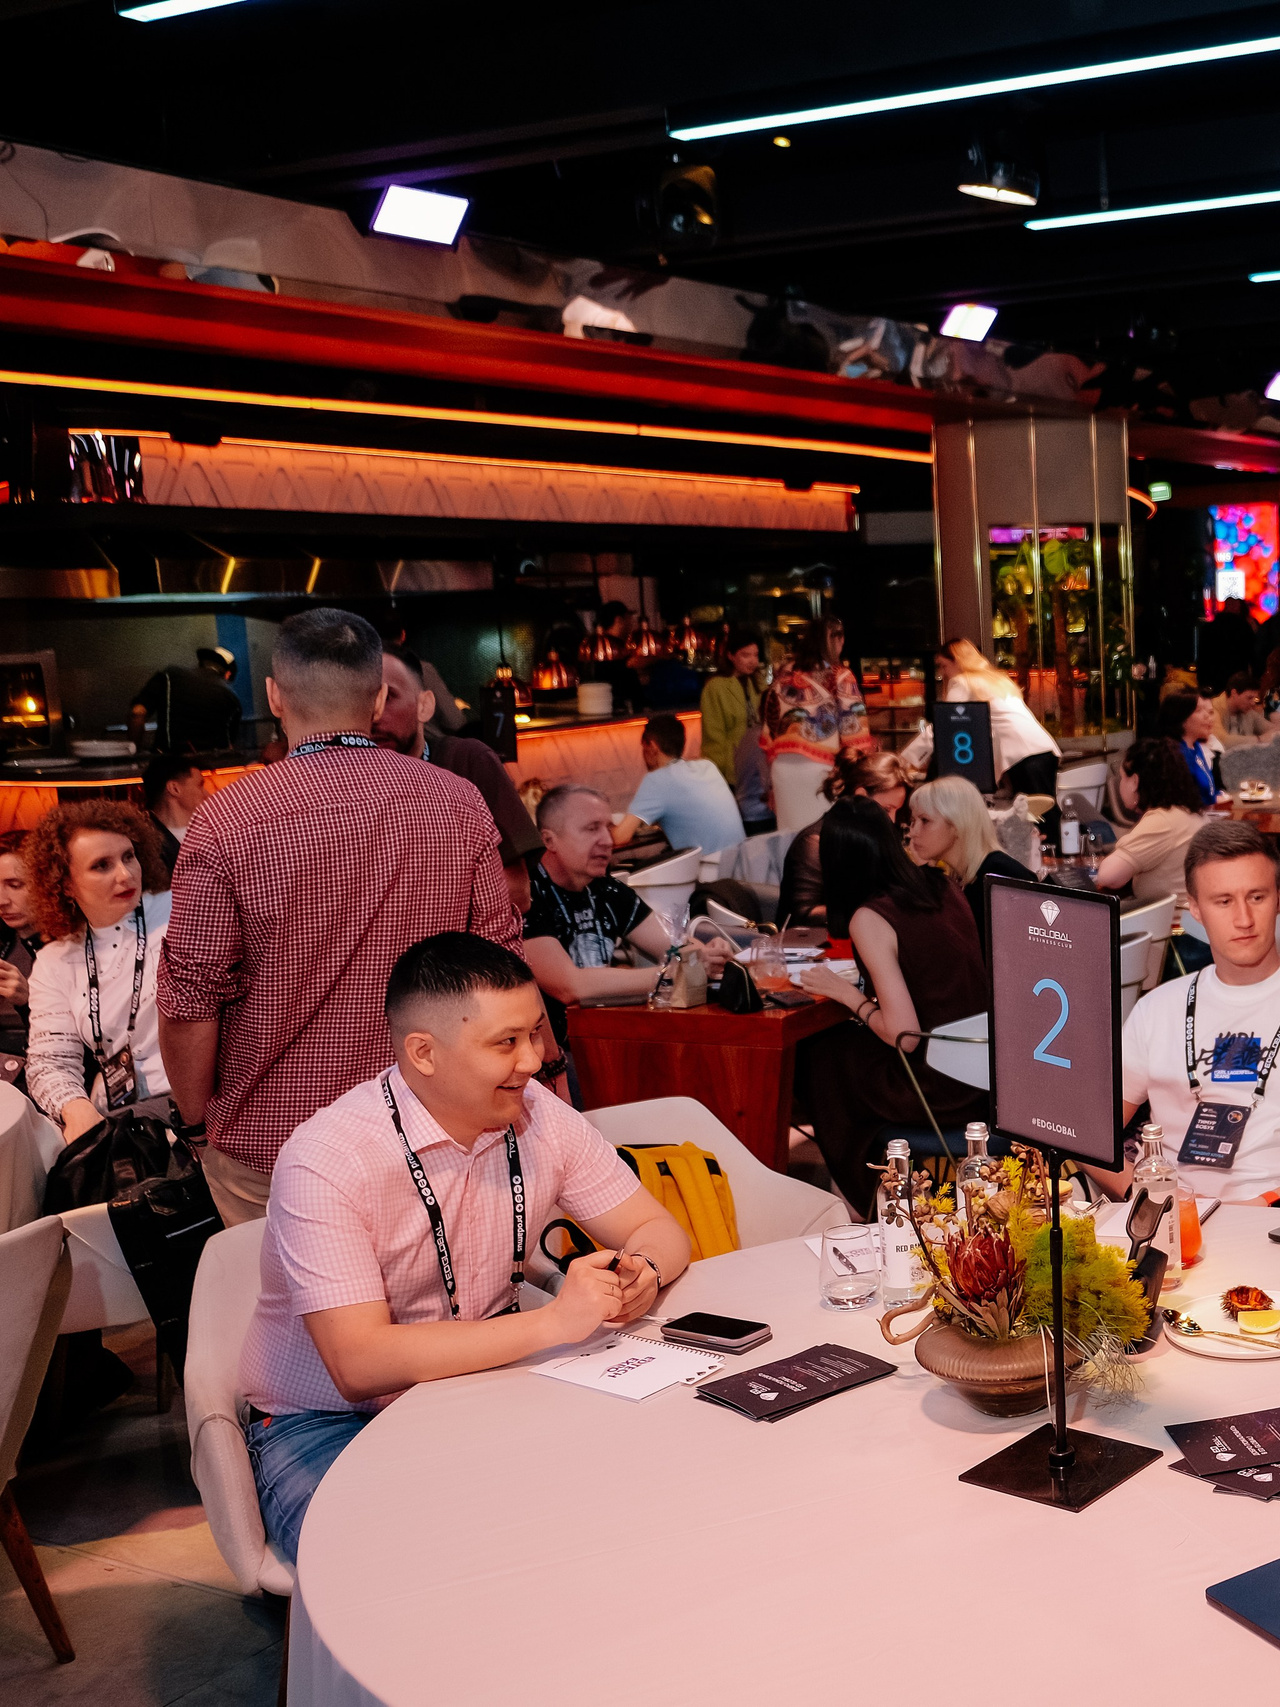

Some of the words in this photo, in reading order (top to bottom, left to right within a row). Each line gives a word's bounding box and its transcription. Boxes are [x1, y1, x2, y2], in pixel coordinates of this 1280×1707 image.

[493, 711, 505, 738] 7
[954, 731, 975, 765] 8
[1028, 925, 1073, 943] EDGLOBAL
[1057, 941, 1073, 949] CLUB
[1032, 977, 1072, 1070] 2
[1031, 1116, 1077, 1138] #EDGLOBAL
[398, 1132, 420, 1170] prodamus
[514, 1214, 526, 1253] prodamus
[434, 1220, 453, 1282] EDGLOBAL
[895, 1244, 909, 1253] RED
[606, 1356, 640, 1373] EXPO
[607, 1356, 657, 1379] EDTECH
